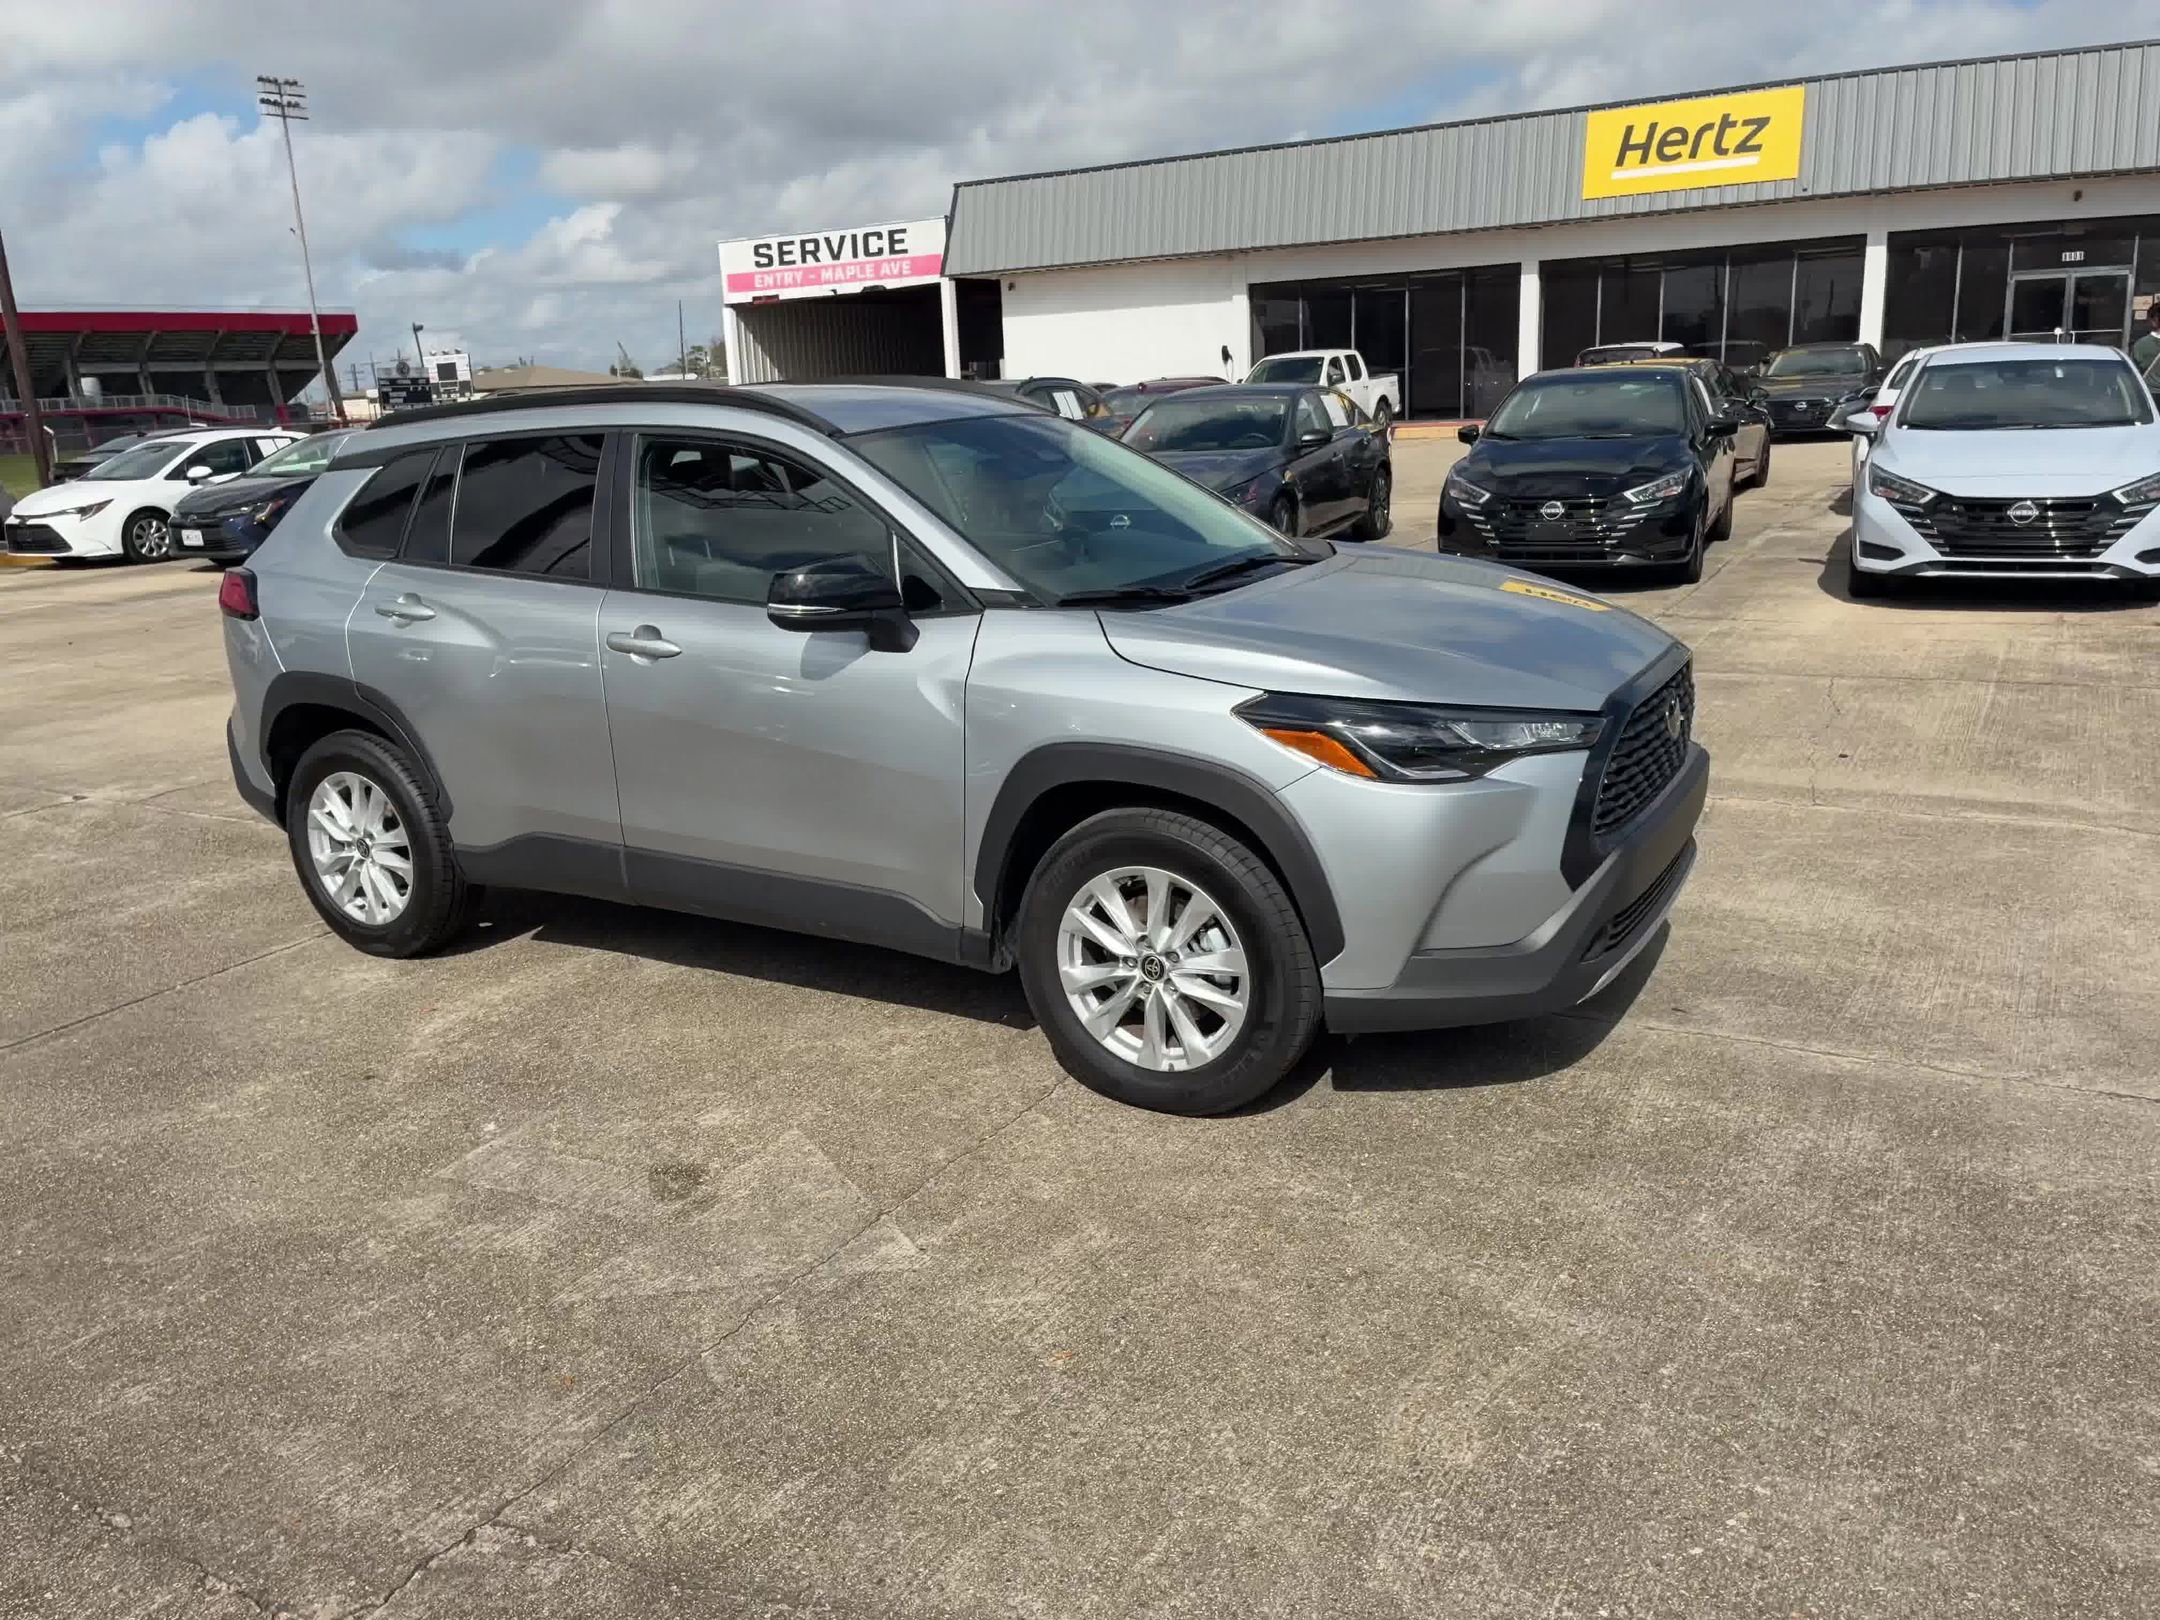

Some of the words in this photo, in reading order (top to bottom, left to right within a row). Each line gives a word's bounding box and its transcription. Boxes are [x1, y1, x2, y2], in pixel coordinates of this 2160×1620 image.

[1615, 113, 1771, 167] Hertz
[754, 228, 909, 268] SERVICE
[754, 273, 803, 288] ENTRY
[821, 264, 875, 282] MAPLE
[880, 260, 912, 276] AVE
